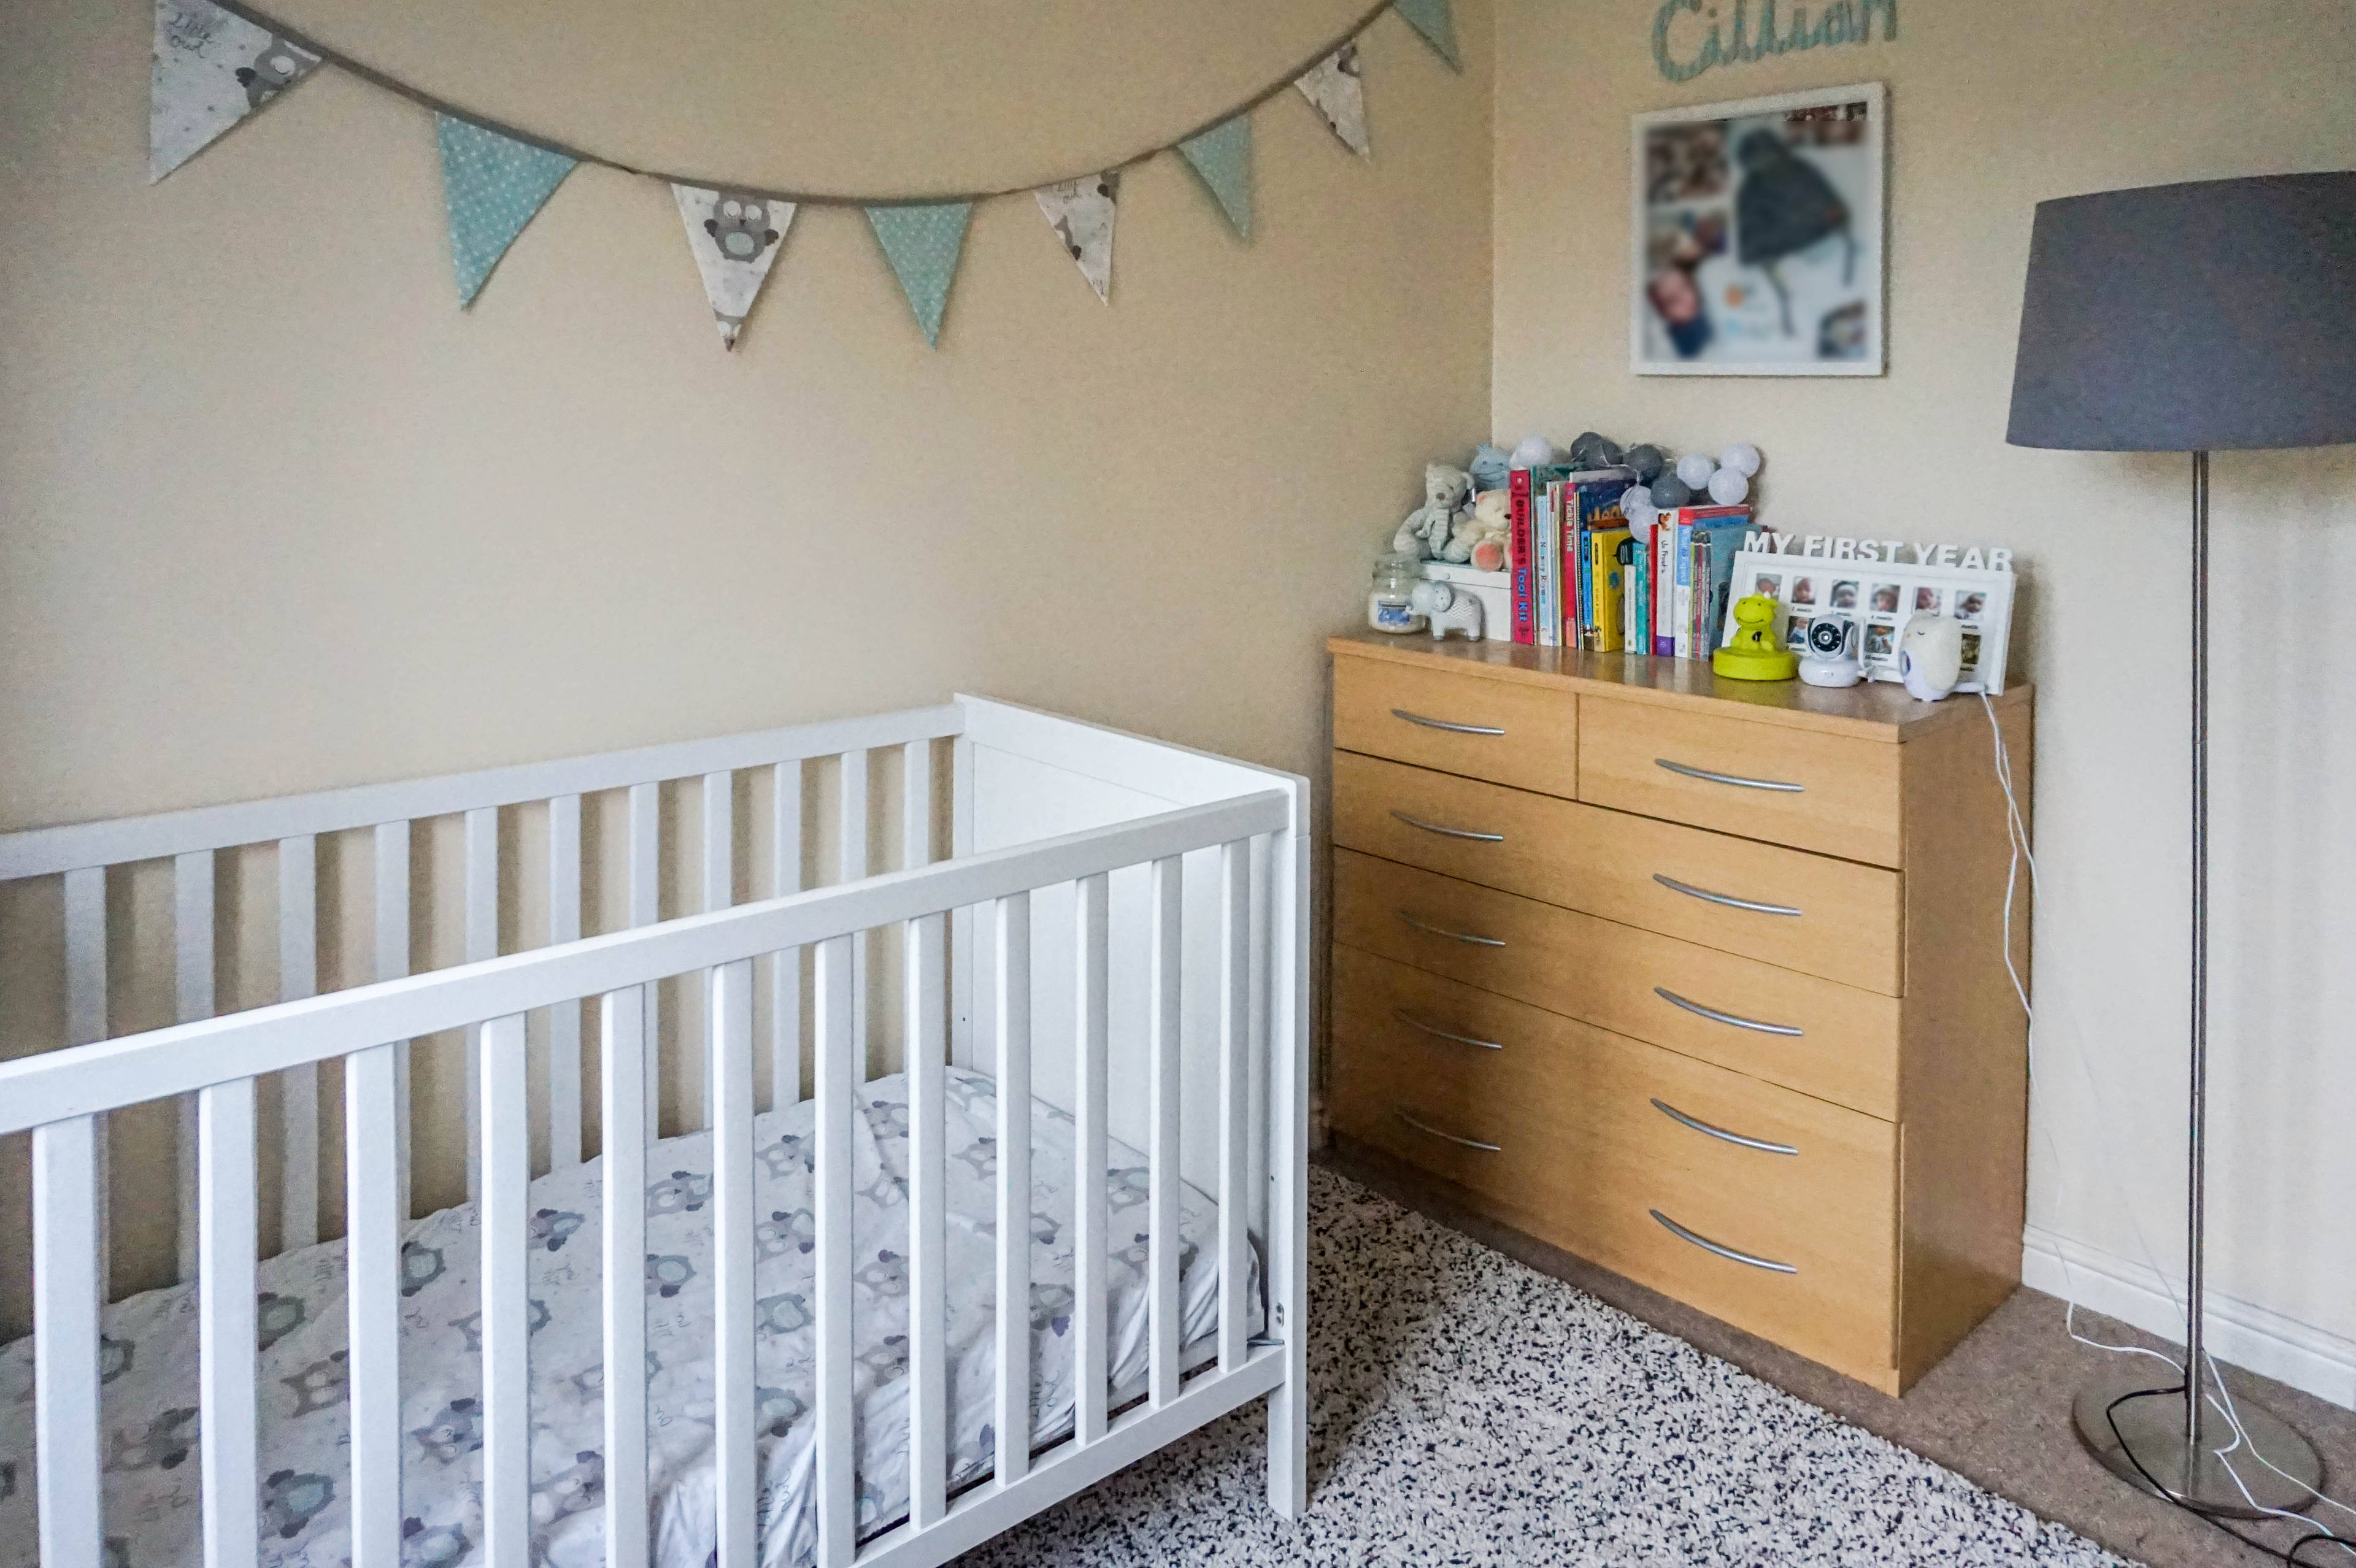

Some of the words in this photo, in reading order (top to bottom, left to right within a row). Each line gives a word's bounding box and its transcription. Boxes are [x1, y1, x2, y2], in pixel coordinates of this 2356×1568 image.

[1516, 499, 1526, 564] BUILDER'S
[1744, 531, 1796, 555] MY
[1803, 535, 1904, 563] FIRST
[1914, 542, 2013, 571] YEAR
[1518, 567, 1528, 598] Tool
[1519, 601, 1528, 622] Kit
